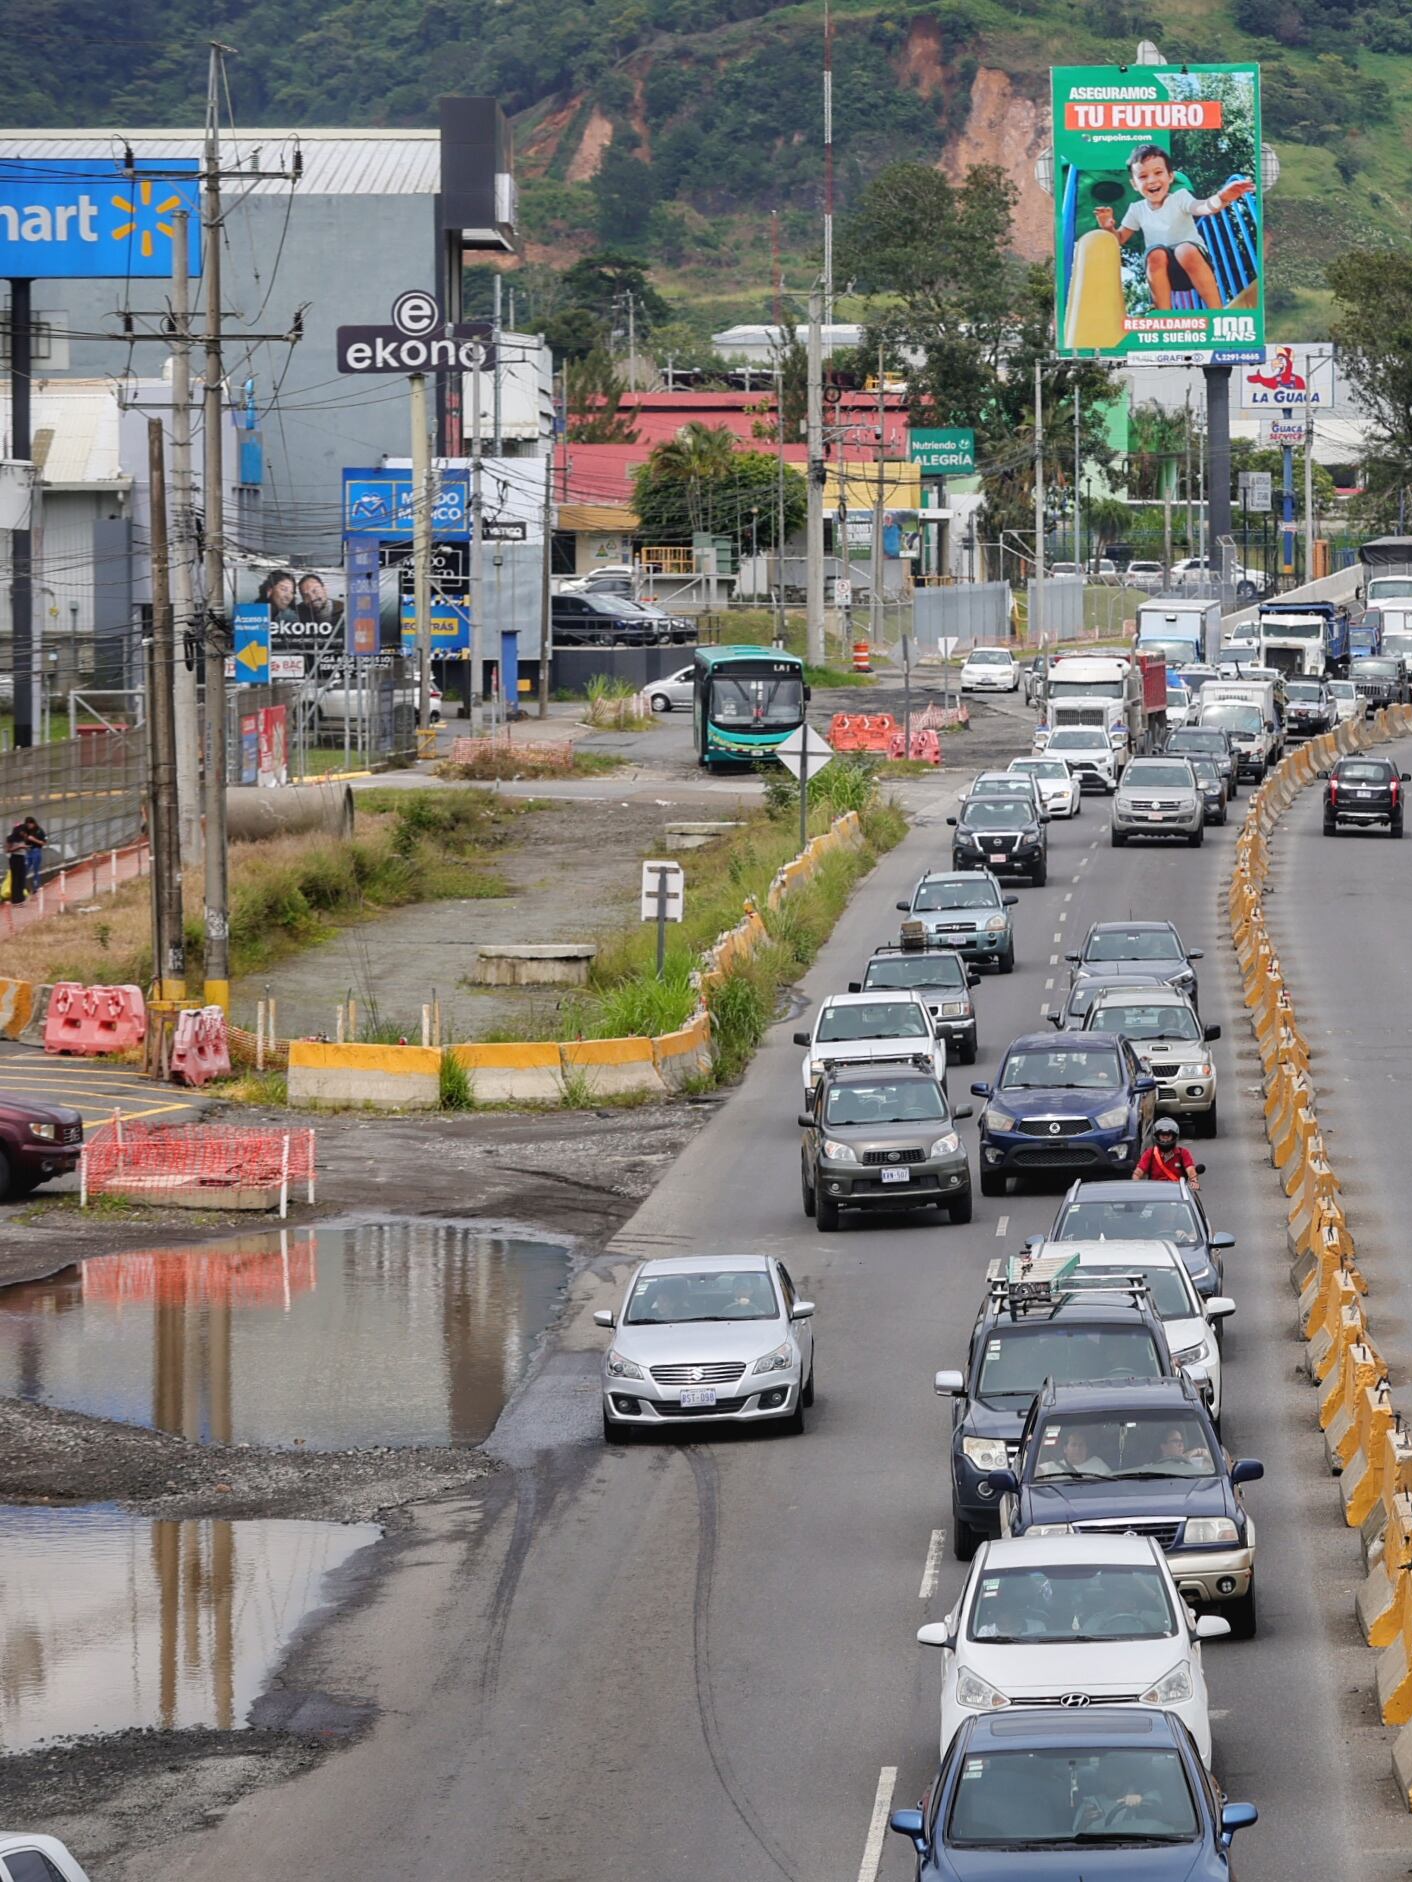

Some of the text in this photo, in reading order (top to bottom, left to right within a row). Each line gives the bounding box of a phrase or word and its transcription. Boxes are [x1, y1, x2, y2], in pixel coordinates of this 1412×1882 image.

[1069, 86, 1158, 100] ASEGURAMOS
[1074, 104, 1204, 127] TU FUTURO
[1092, 133, 1152, 143] grupoins.com
[1124, 316, 1254, 336] RESPALDAMOS 100
[1138, 333, 1159, 343] TUS
[1163, 330, 1207, 343] SUEÑOS
[346, 337, 487, 370] ekono
[1253, 393, 1268, 403] LA
[1272, 424, 1302, 432] GUACA
[912, 441, 956, 450] Nutriendo
[913, 451, 973, 465] ALEGRÍA
[270, 619, 333, 635] ekono
